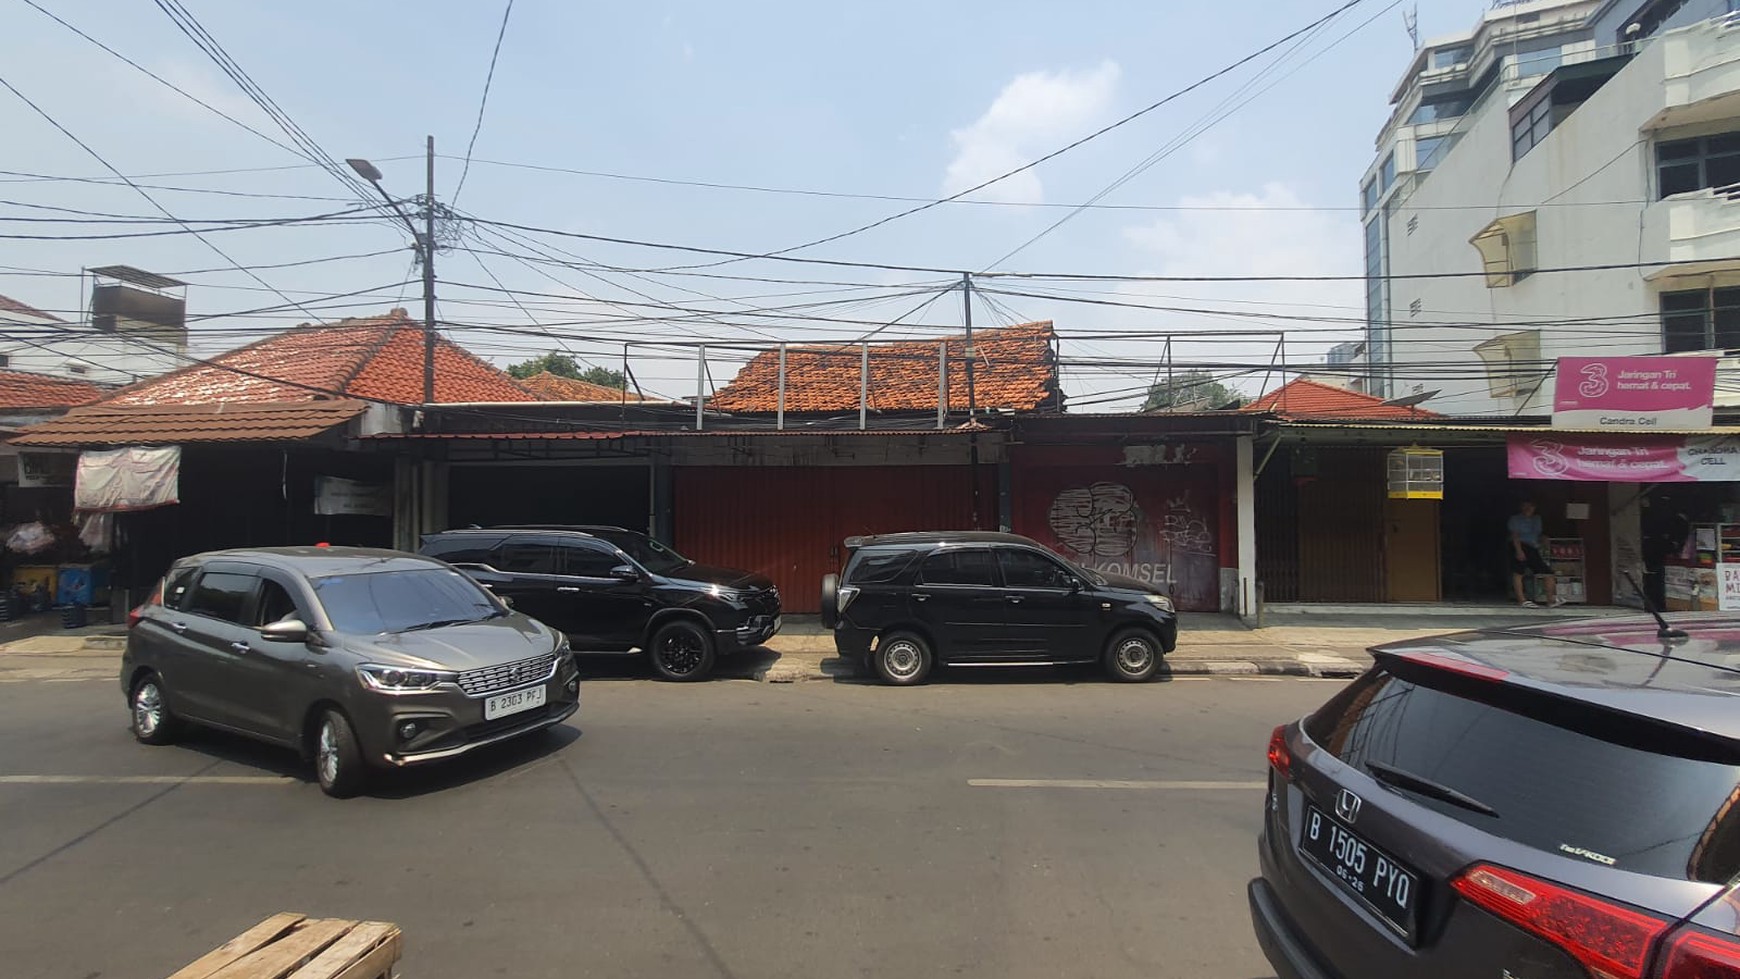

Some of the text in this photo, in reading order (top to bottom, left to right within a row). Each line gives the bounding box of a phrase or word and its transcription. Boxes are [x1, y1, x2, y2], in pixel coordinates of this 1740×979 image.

[1617, 370, 1662, 380] Jaringan
[1617, 381, 1649, 390] hemat
[1638, 416, 1657, 425] Cell
[1577, 446, 1631, 458] Jaringan
[490, 700, 497, 712] B
[1310, 812, 1410, 908] B 1505 PYQ
